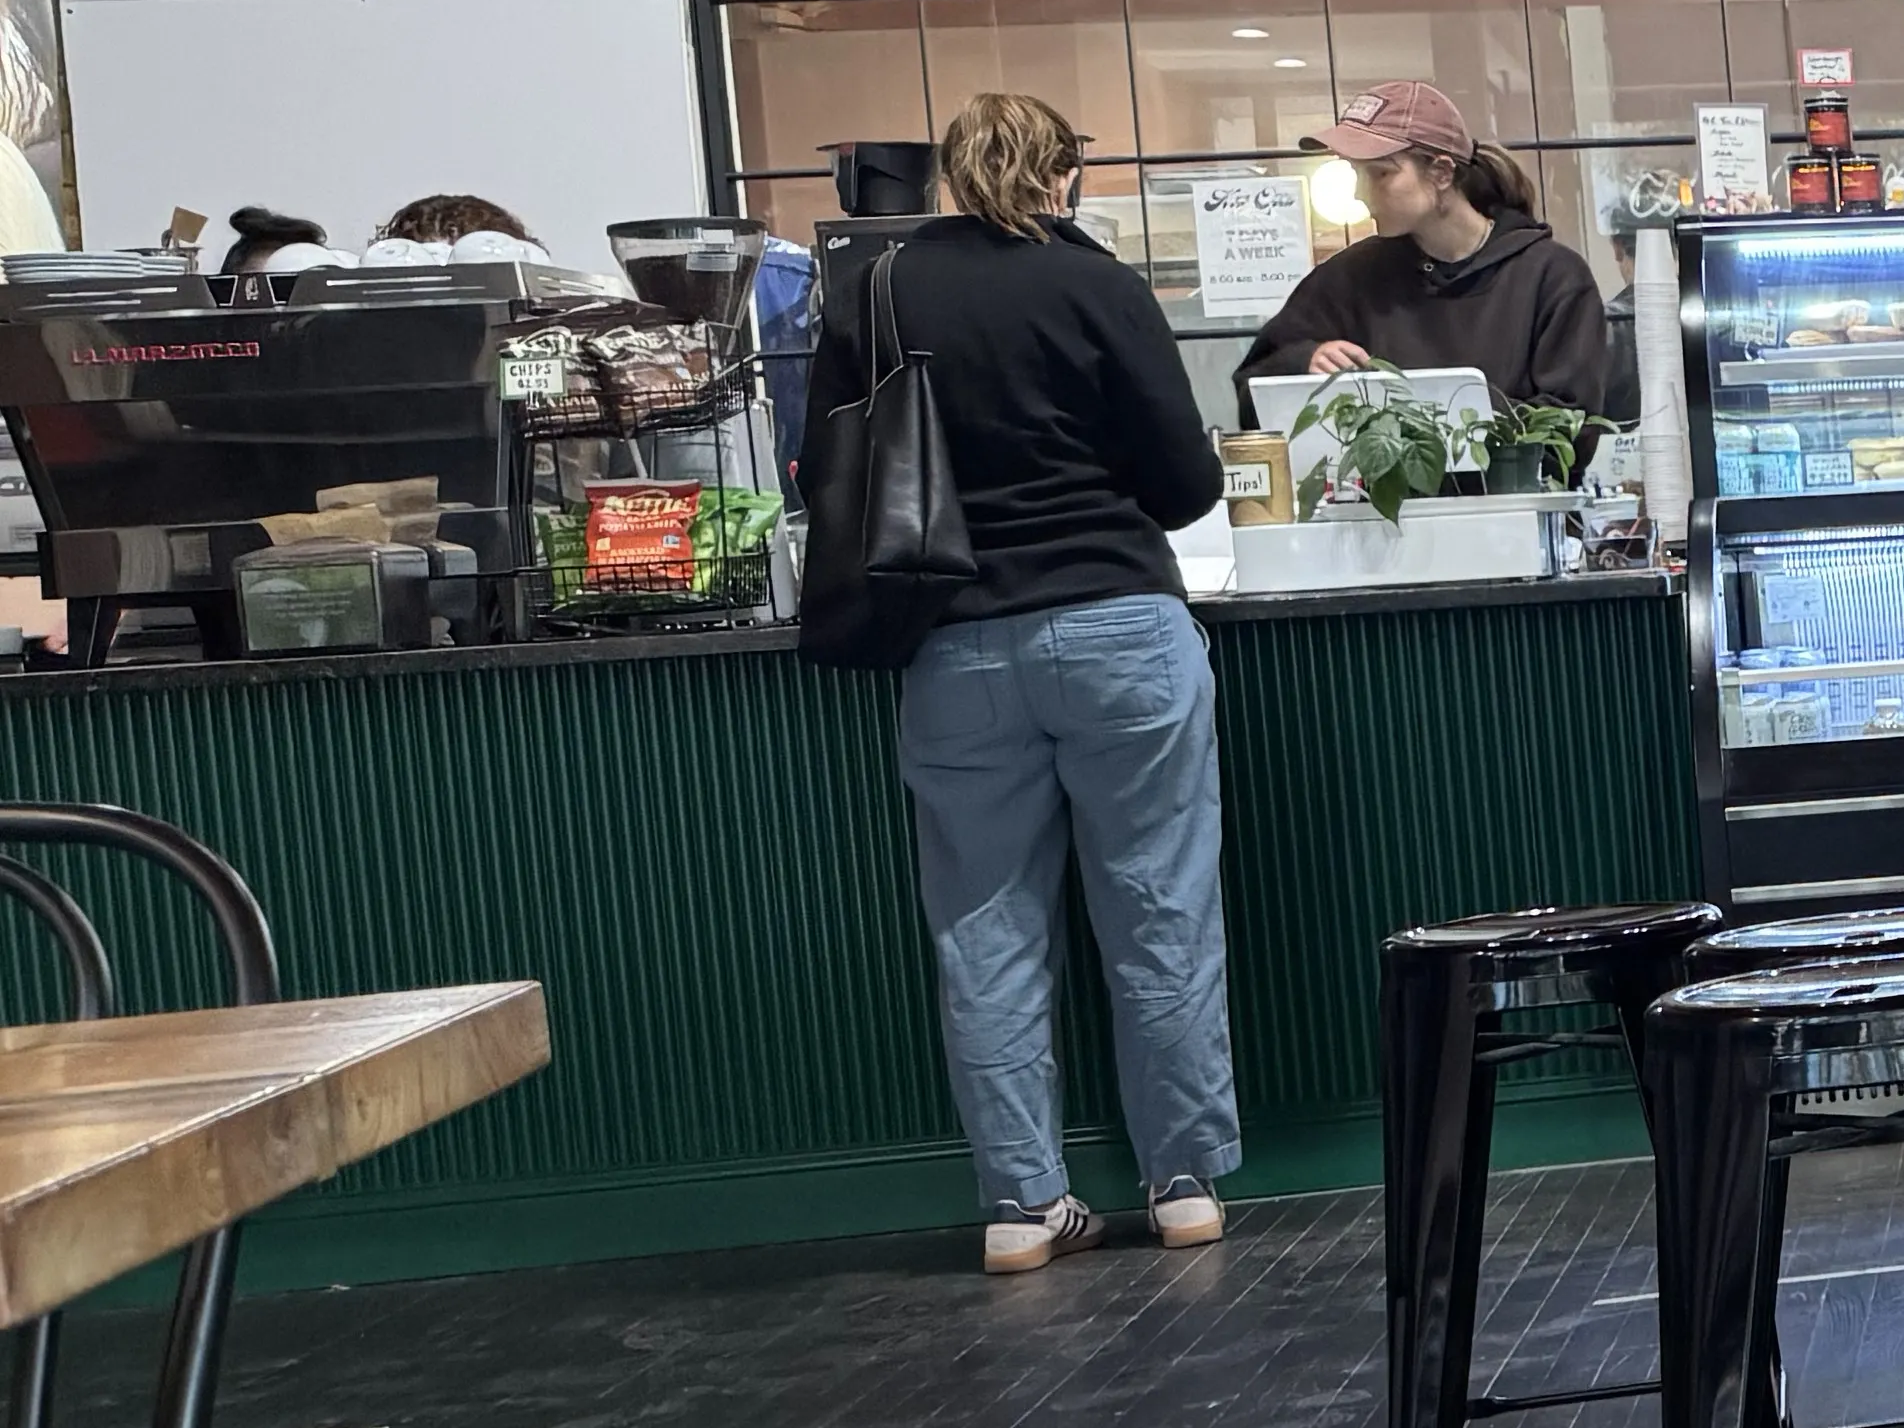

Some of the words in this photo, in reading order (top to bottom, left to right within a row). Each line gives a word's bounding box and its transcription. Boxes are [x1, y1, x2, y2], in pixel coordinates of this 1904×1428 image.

[1239, 245, 1286, 260] WEEK
[509, 362, 553, 377] CHIPS
[1225, 470, 1263, 493] Tips!
